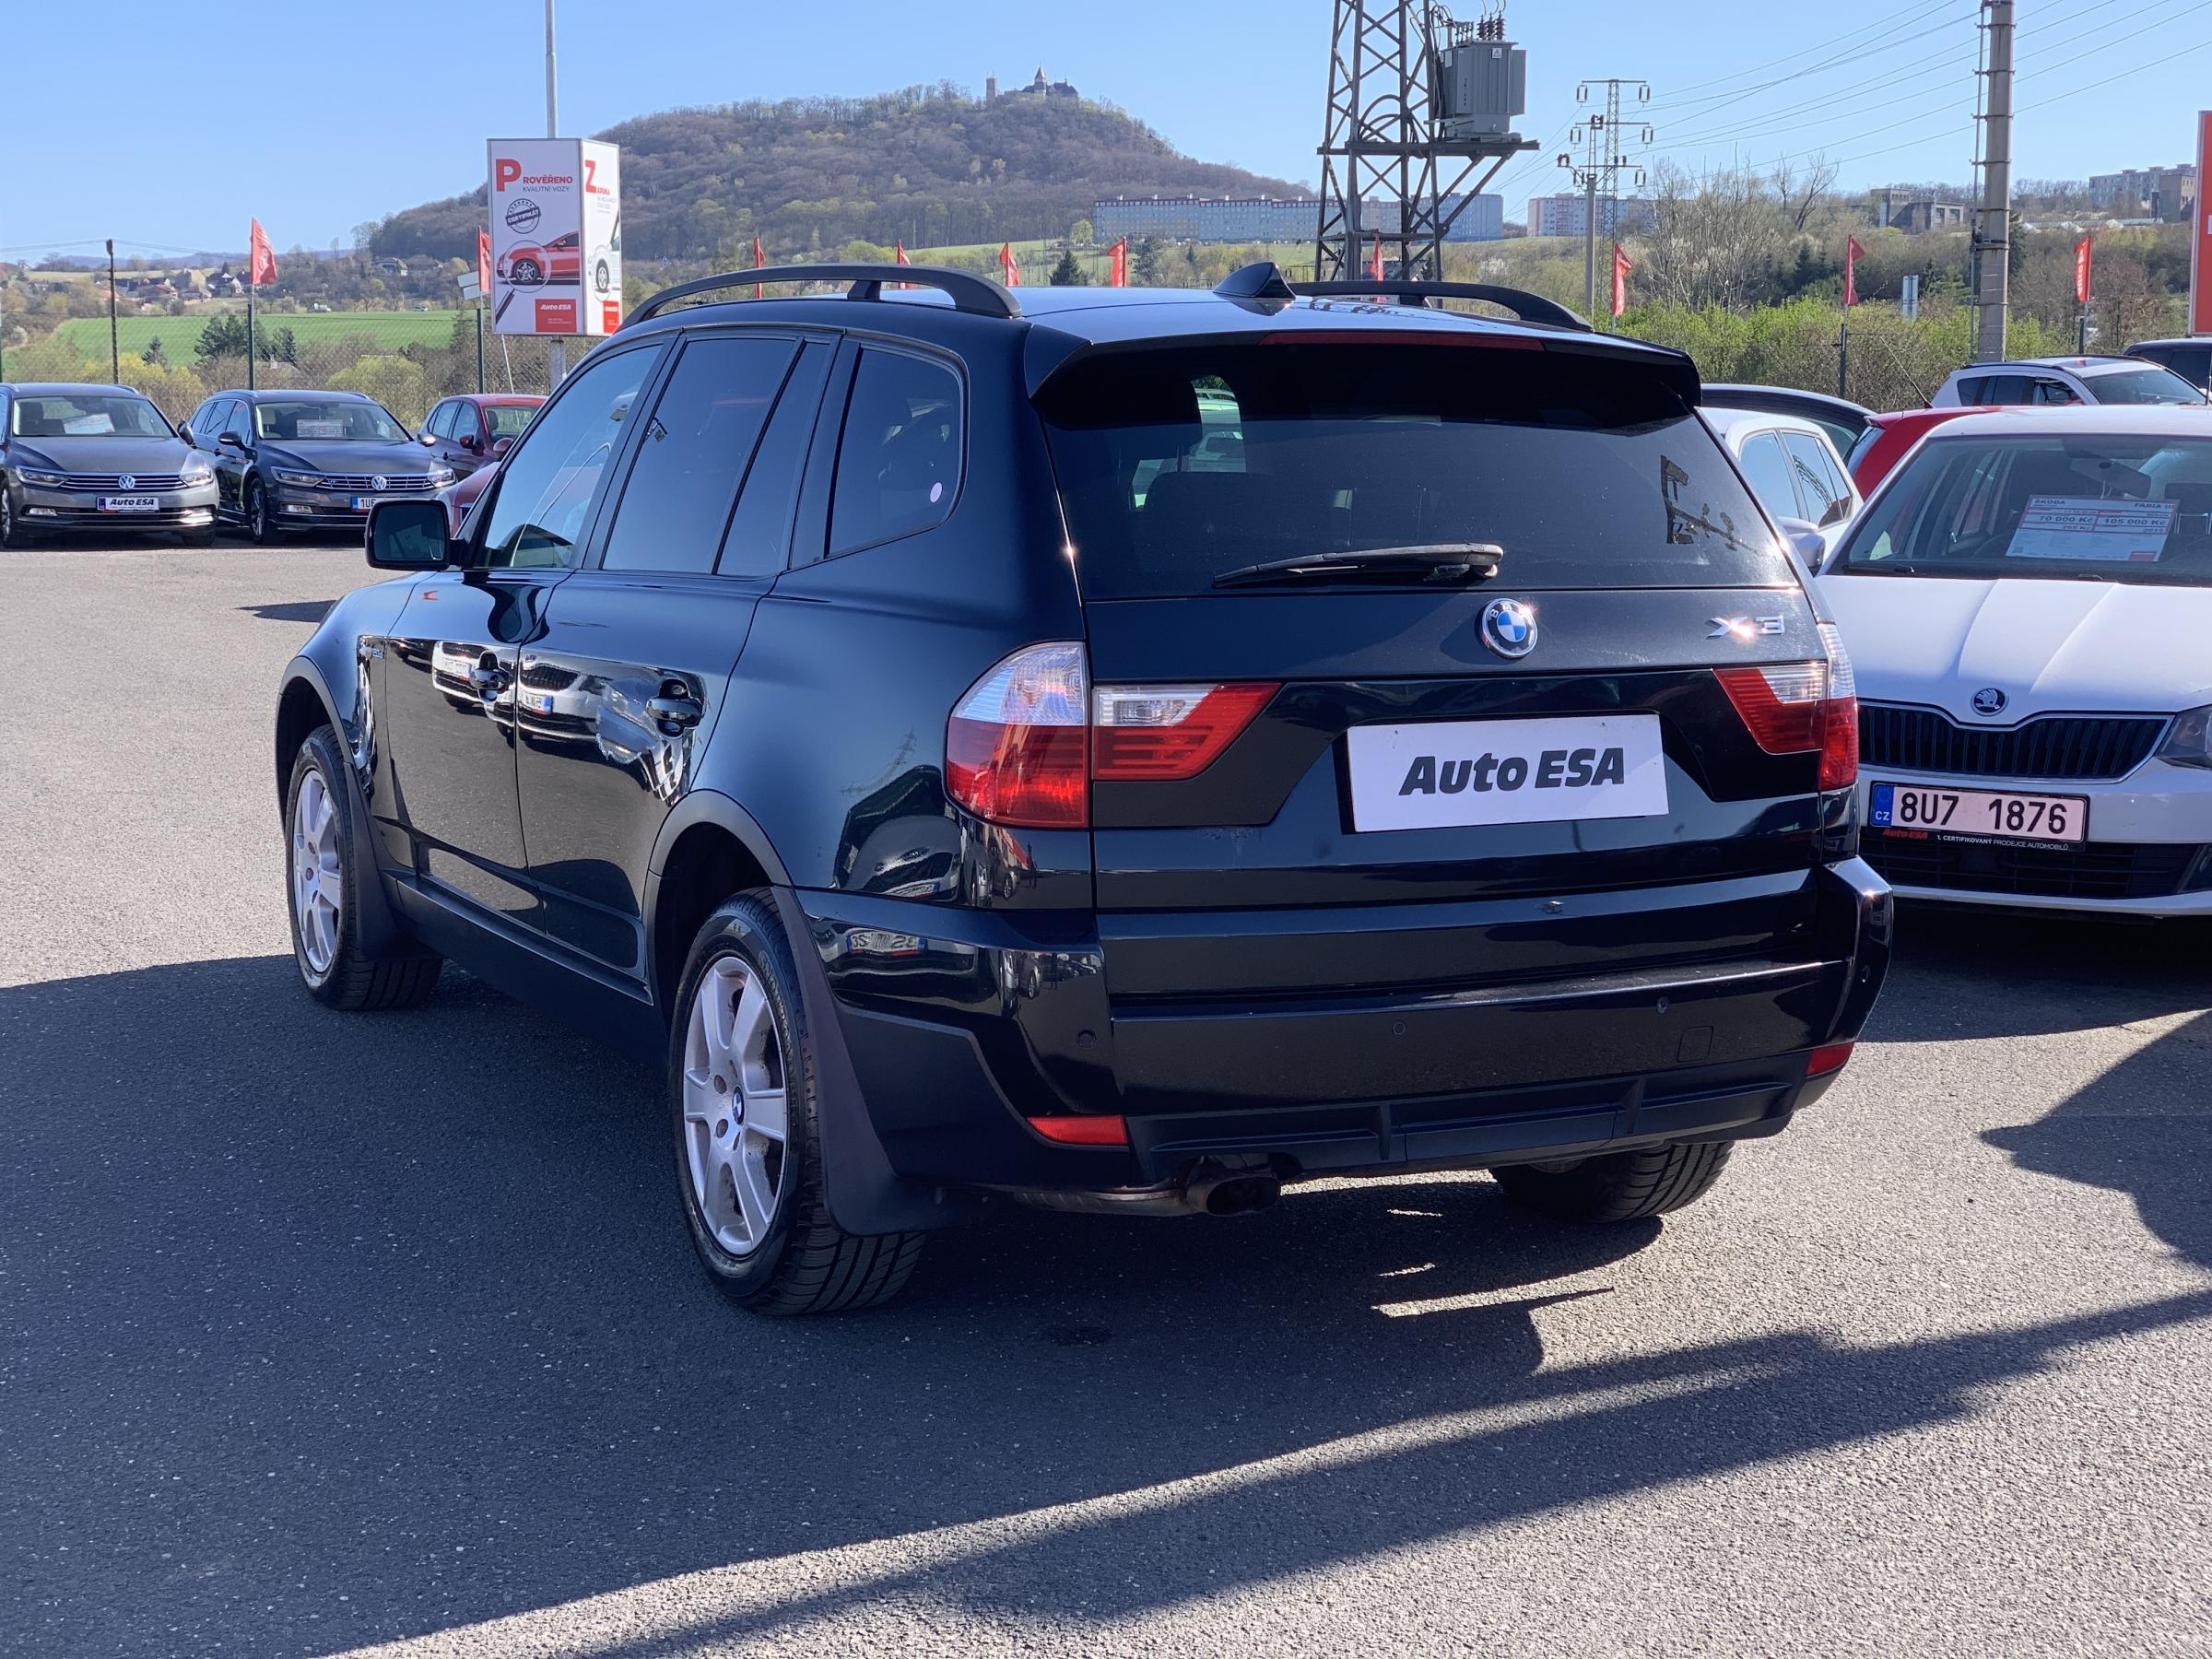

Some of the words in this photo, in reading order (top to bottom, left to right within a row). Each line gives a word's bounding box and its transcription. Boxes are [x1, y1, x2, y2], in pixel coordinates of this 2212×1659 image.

[1706, 616, 1784, 640] X3
[1398, 752, 1528, 795] Auto
[1535, 747, 1625, 789] ESA
[1875, 810, 1890, 821] CZ
[1900, 792, 1959, 826] 8U7
[1988, 798, 2068, 834] 1876
[1993, 839, 2027, 848] PRODEJCE
